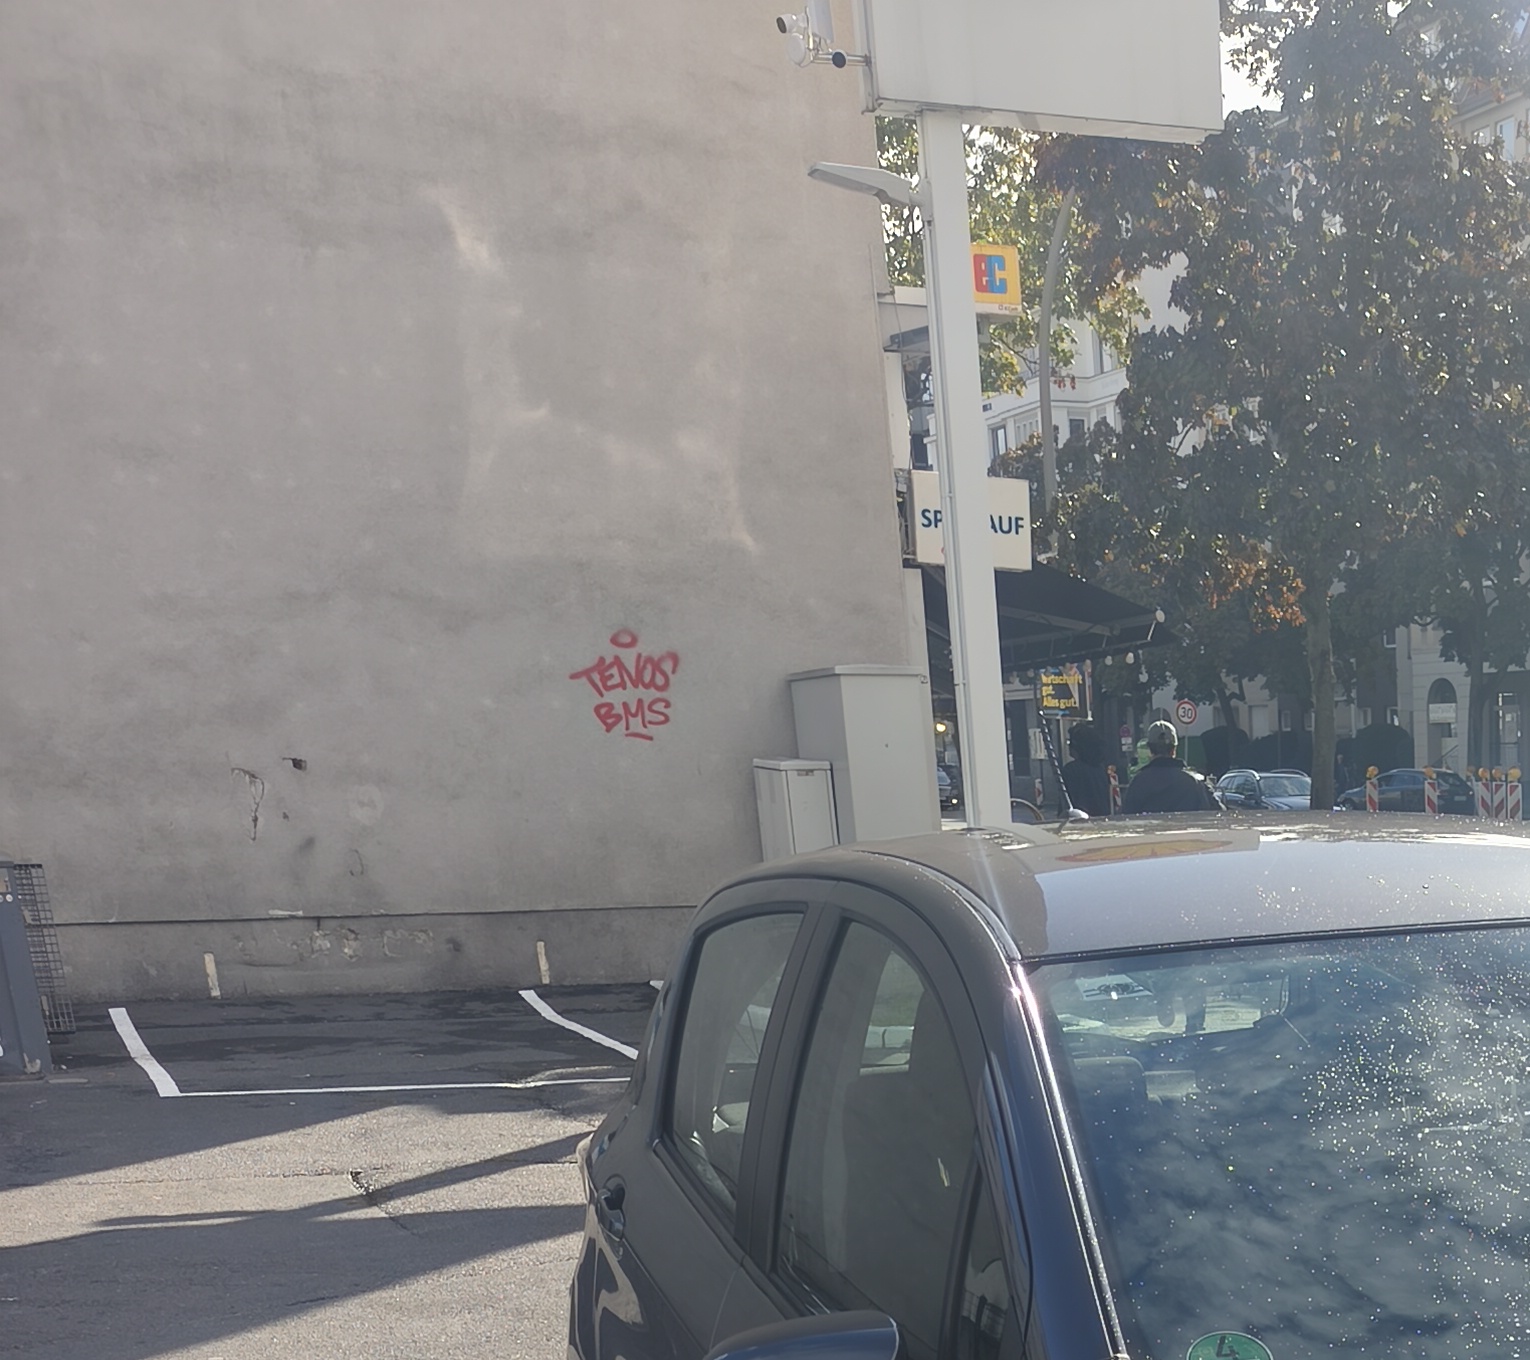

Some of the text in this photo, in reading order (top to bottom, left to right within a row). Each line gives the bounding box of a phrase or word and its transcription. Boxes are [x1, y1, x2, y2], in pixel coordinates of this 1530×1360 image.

[921, 508, 1024, 535] SPAUF
[594, 698, 671, 733] BMS
[1180, 707, 1192, 719] 30
[1216, 1335, 1240, 1360] 4
